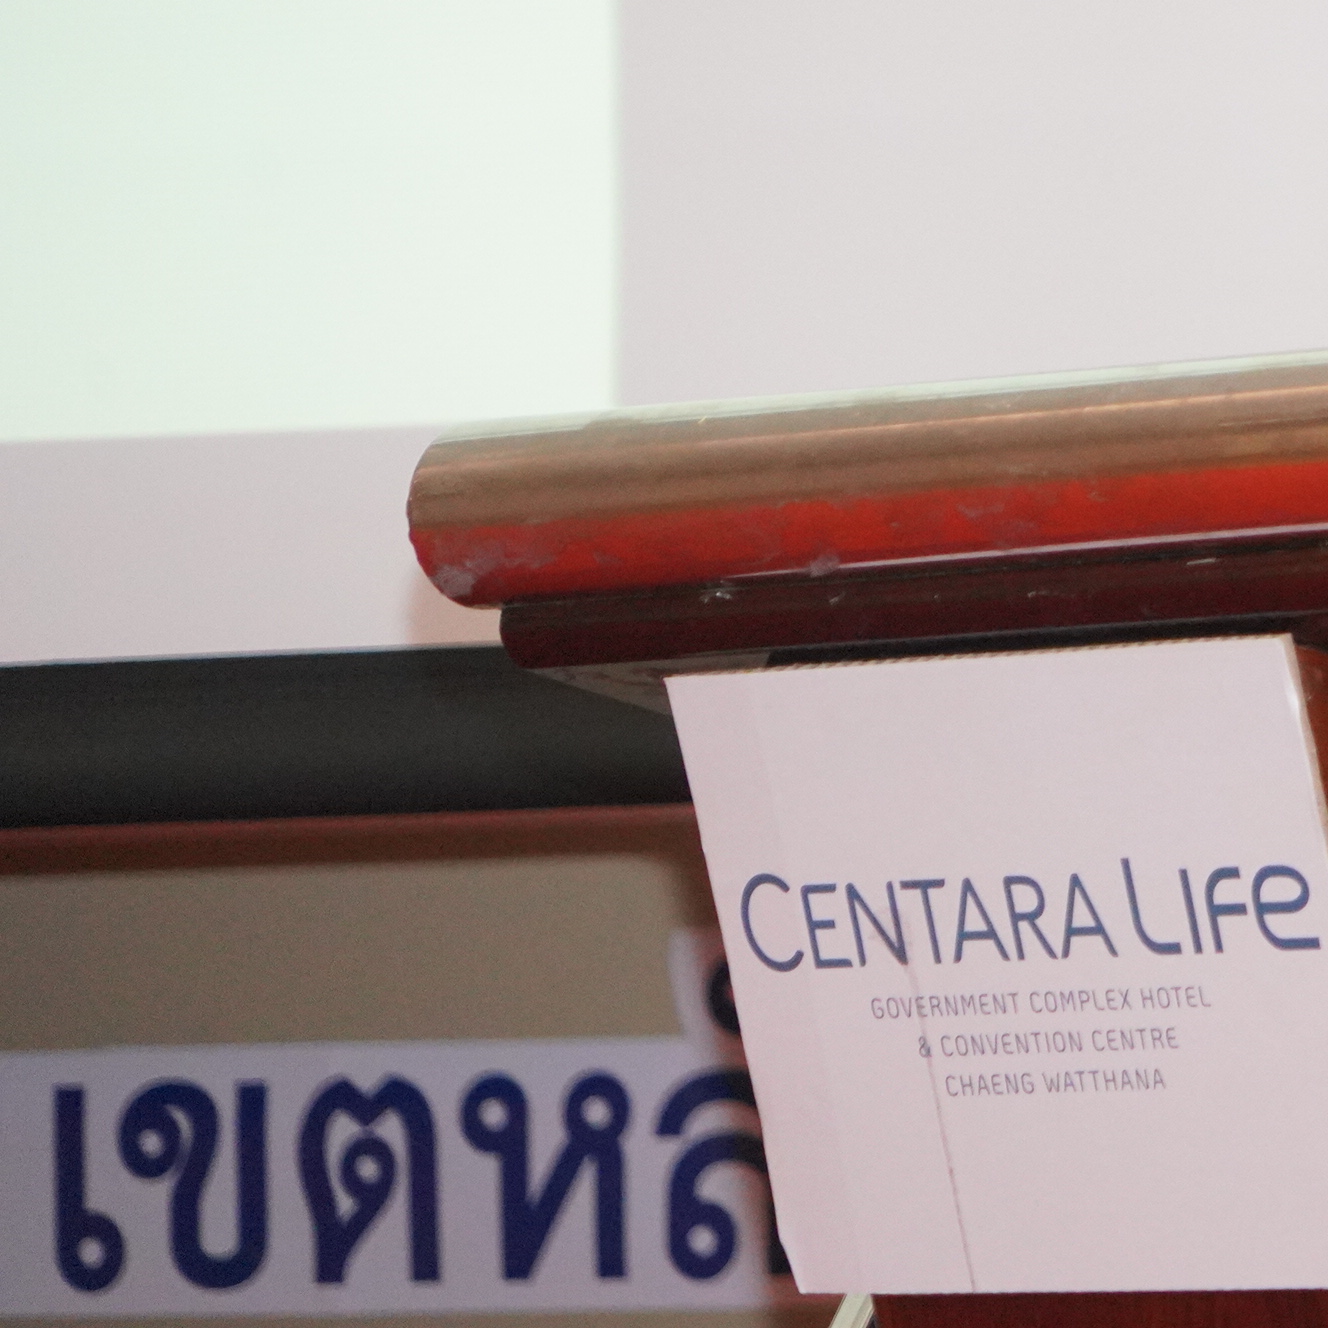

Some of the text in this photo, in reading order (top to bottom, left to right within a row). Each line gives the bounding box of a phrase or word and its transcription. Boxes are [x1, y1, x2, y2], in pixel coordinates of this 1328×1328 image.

[741, 872, 1119, 972] CENTARA
[870, 985, 1212, 1020] GOVERNMENT COMPLEX HOTEL
[917, 1026, 1180, 1059] & CONVENTION CENTRE
[944, 1068, 1167, 1098] CHAENG WATTHANA
